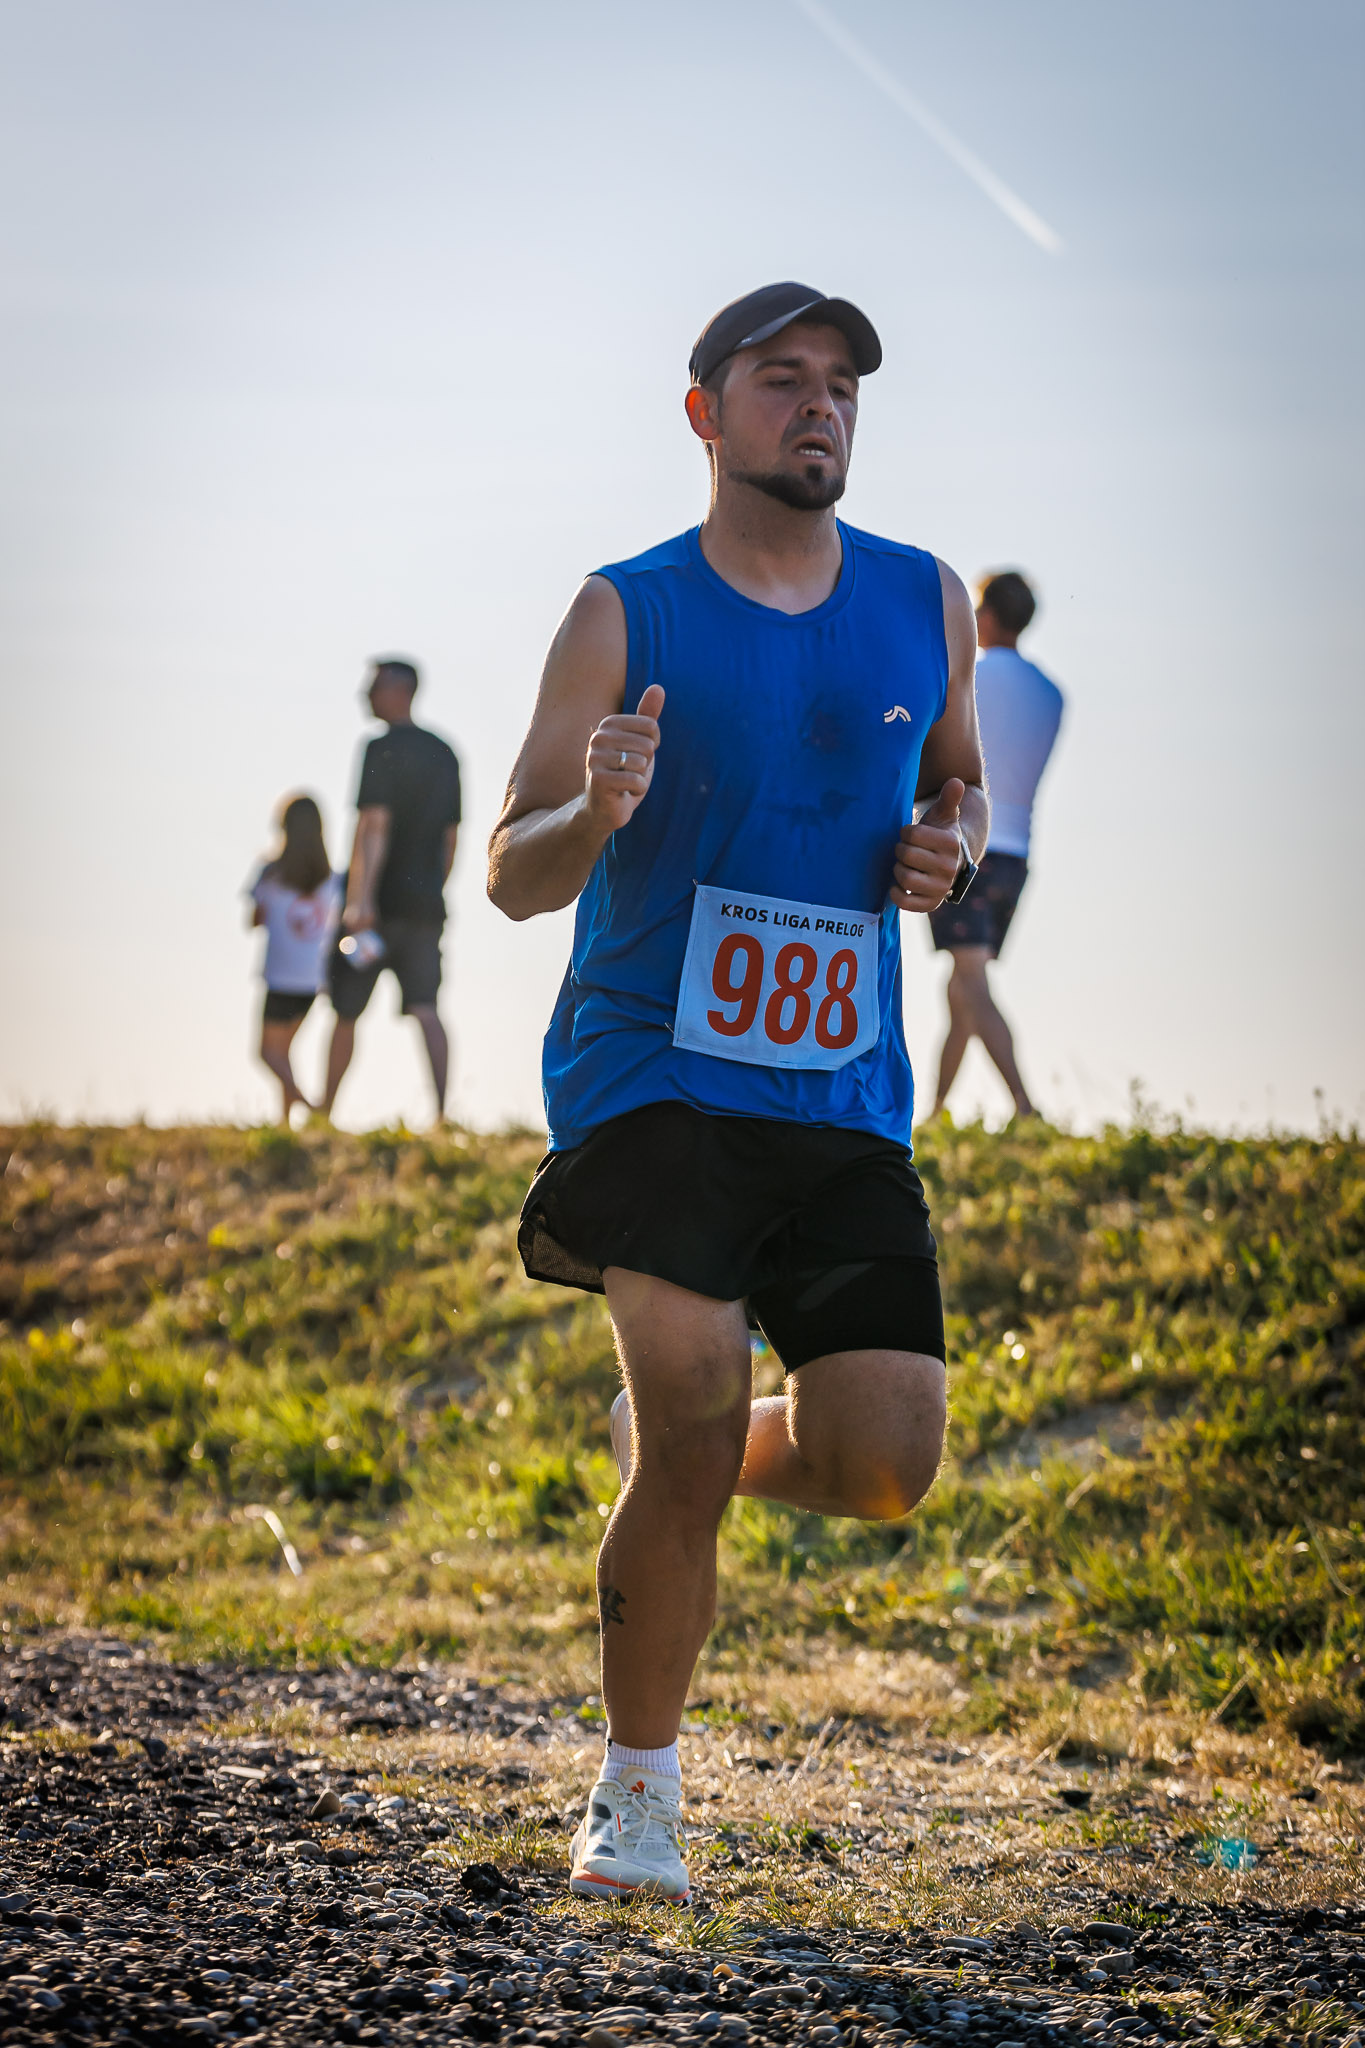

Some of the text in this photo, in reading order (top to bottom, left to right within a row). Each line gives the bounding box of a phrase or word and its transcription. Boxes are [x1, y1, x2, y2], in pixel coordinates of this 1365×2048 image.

[721, 903, 864, 937] KROS LIGA PRELOG
[707, 933, 858, 1049] 988
